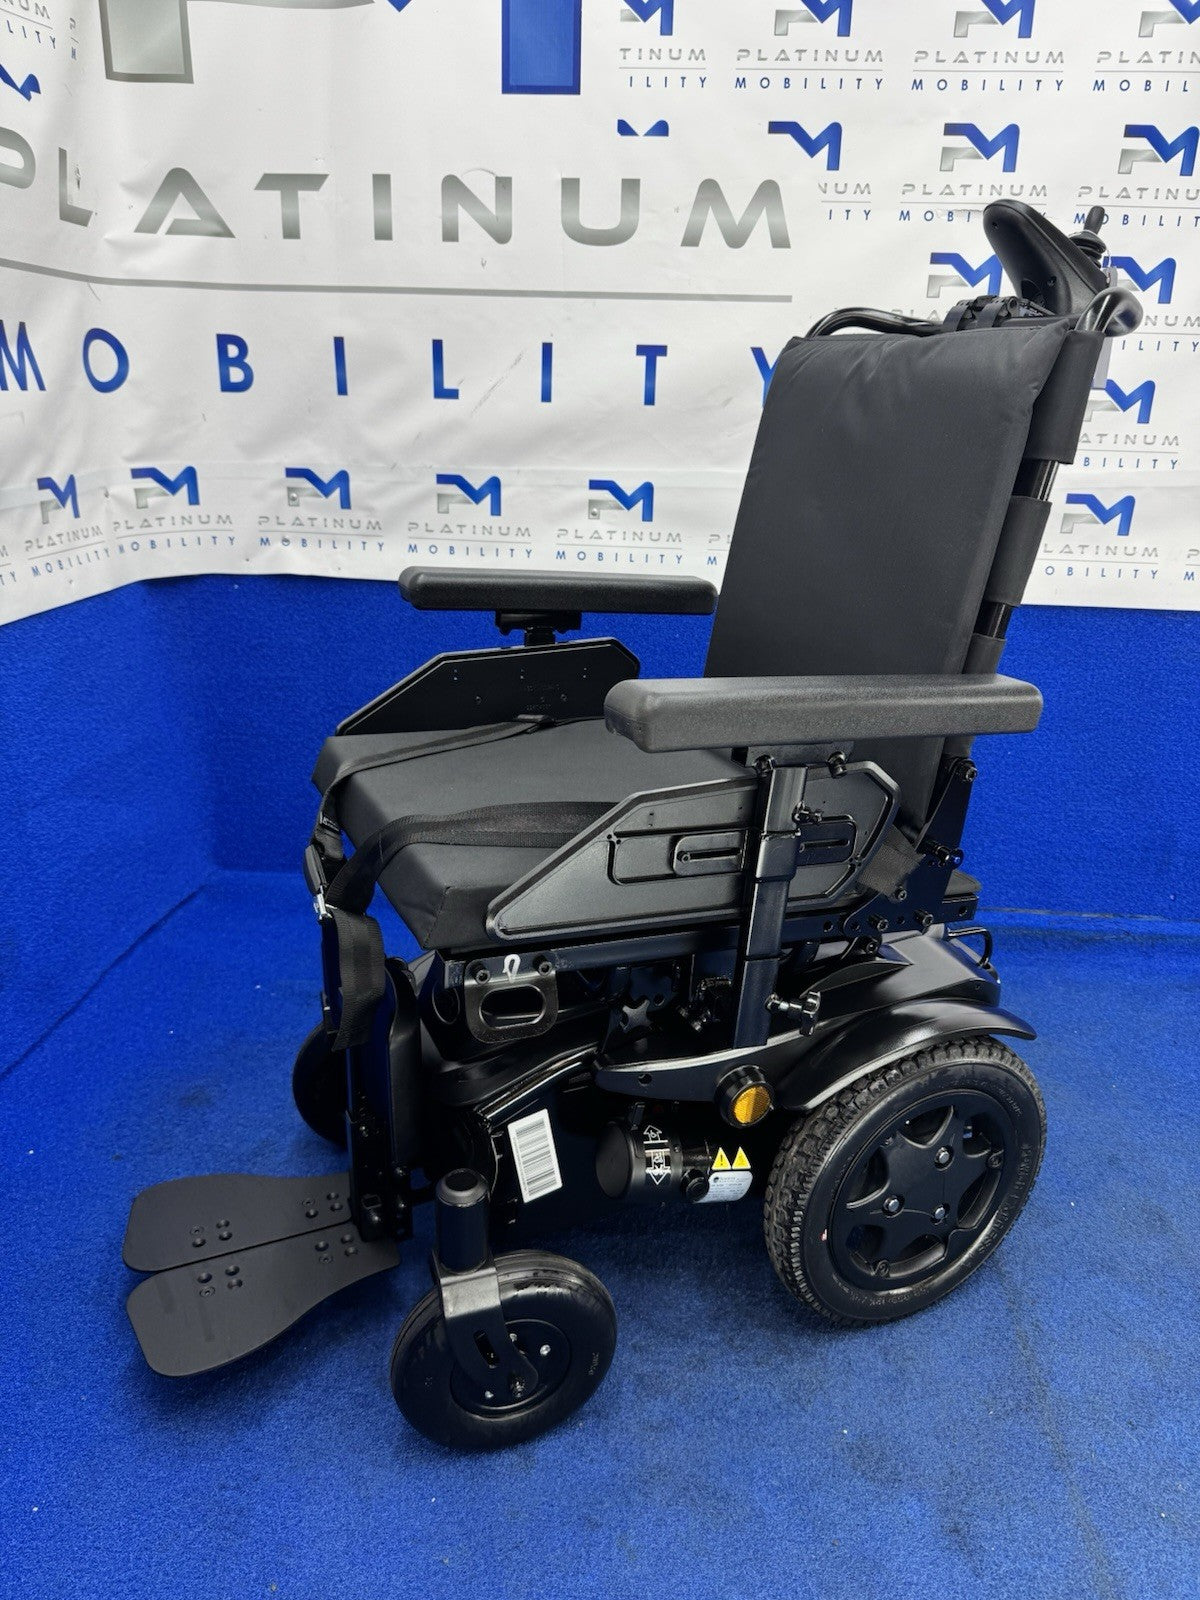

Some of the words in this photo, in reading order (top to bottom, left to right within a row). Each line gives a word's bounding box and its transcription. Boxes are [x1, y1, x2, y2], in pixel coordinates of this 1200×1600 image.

[736, 49, 883, 62] PLATINUM
[914, 50, 1065, 64] PLATINUM
[735, 76, 883, 90] MOBILITY
[911, 79, 1064, 91] MOBILITY
[1092, 79, 1189, 92] MOBIL
[901, 183, 1047, 198] PLATINUM
[113, 514, 233, 532] PLATINUM
[258, 516, 383, 530] PLATINUM
[408, 521, 531, 537] PLATINUM
[25, 525, 103, 552] PLATINUM
[557, 528, 682, 543] PLATINUM
[118, 535, 236, 554] MOBILITY
[260, 537, 385, 551] MOBILITY
[408, 543, 533, 558] MOBILITY
[1043, 543, 1159, 557] LATINUM
[32, 547, 110, 577] MOBILITY
[556, 550, 683, 564] MOBILITY
[1045, 565, 1159, 579] OBILITY
